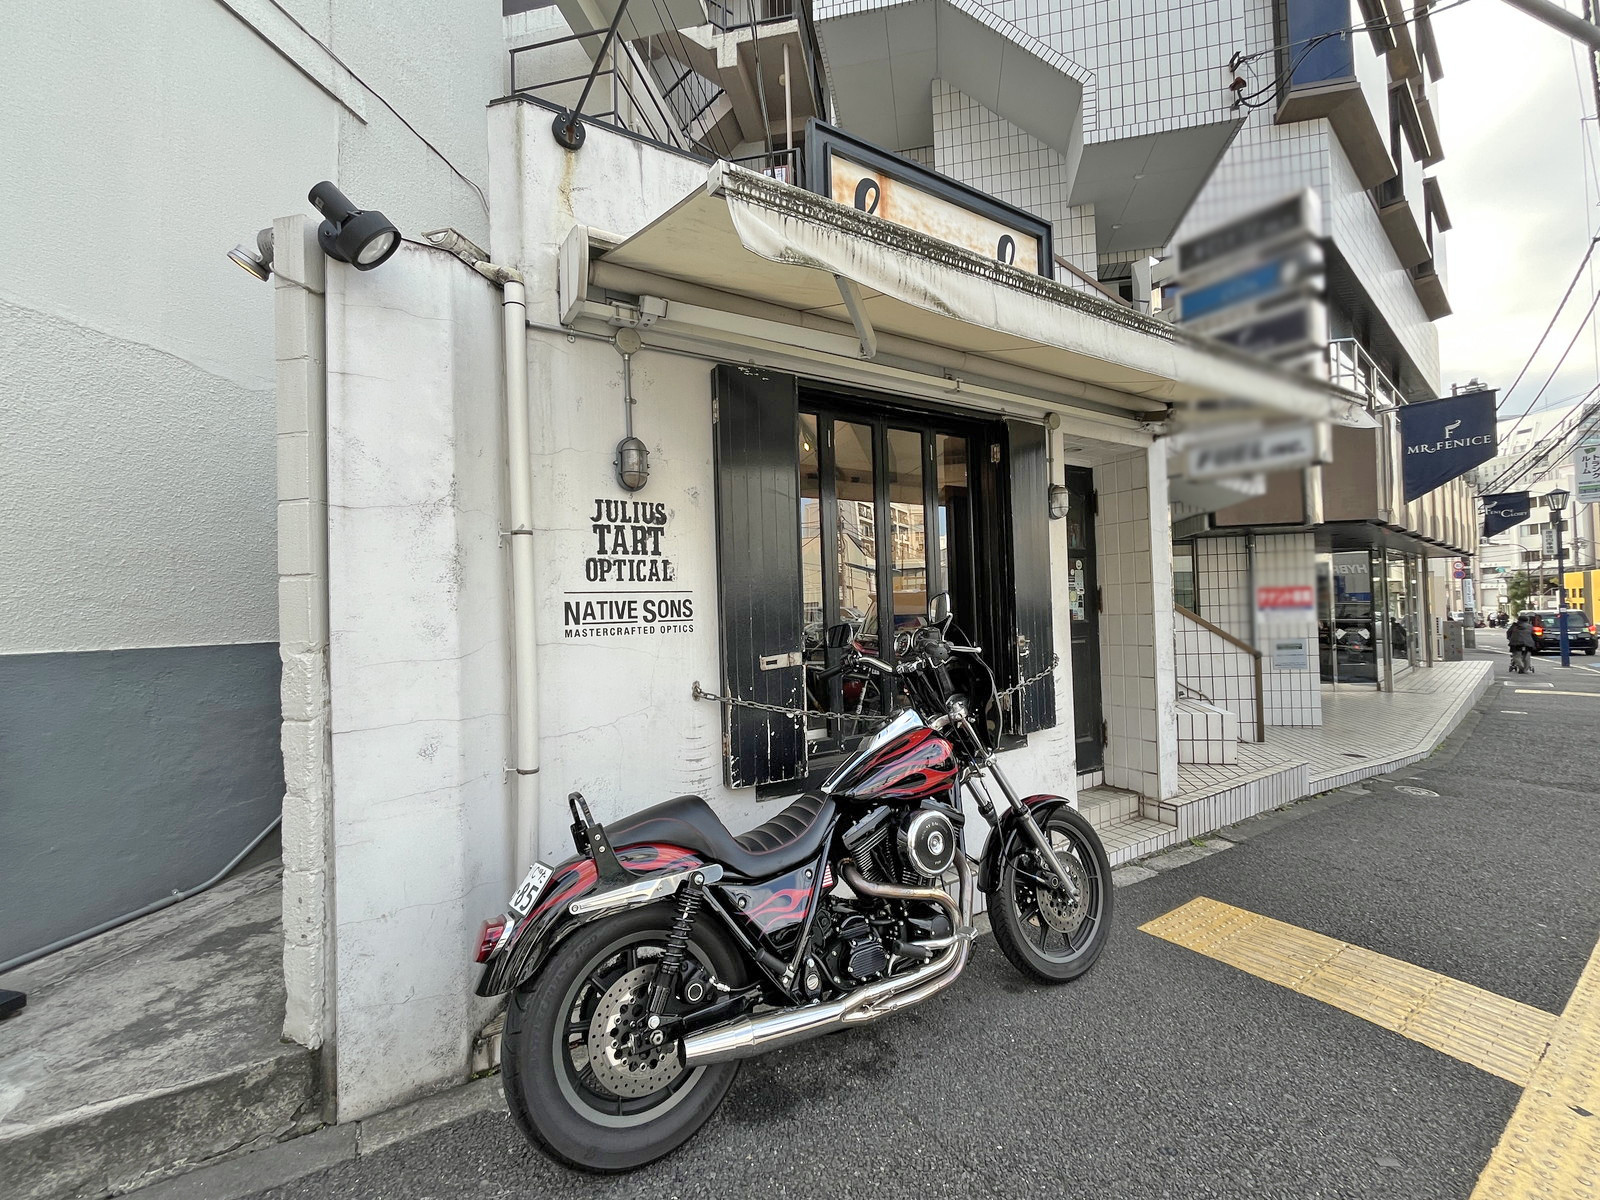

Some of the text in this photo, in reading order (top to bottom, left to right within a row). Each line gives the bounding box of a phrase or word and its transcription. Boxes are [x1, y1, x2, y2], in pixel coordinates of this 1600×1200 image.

[1581, 455, 1592, 475] ルーム
[590, 499, 667, 525] JULIUS
[592, 524, 664, 556] TART
[585, 557, 673, 582] OPTICAL
[564, 599, 694, 626] NATIVE SONS
[564, 624, 694, 638] MASTERCRAFTED OPTICS
